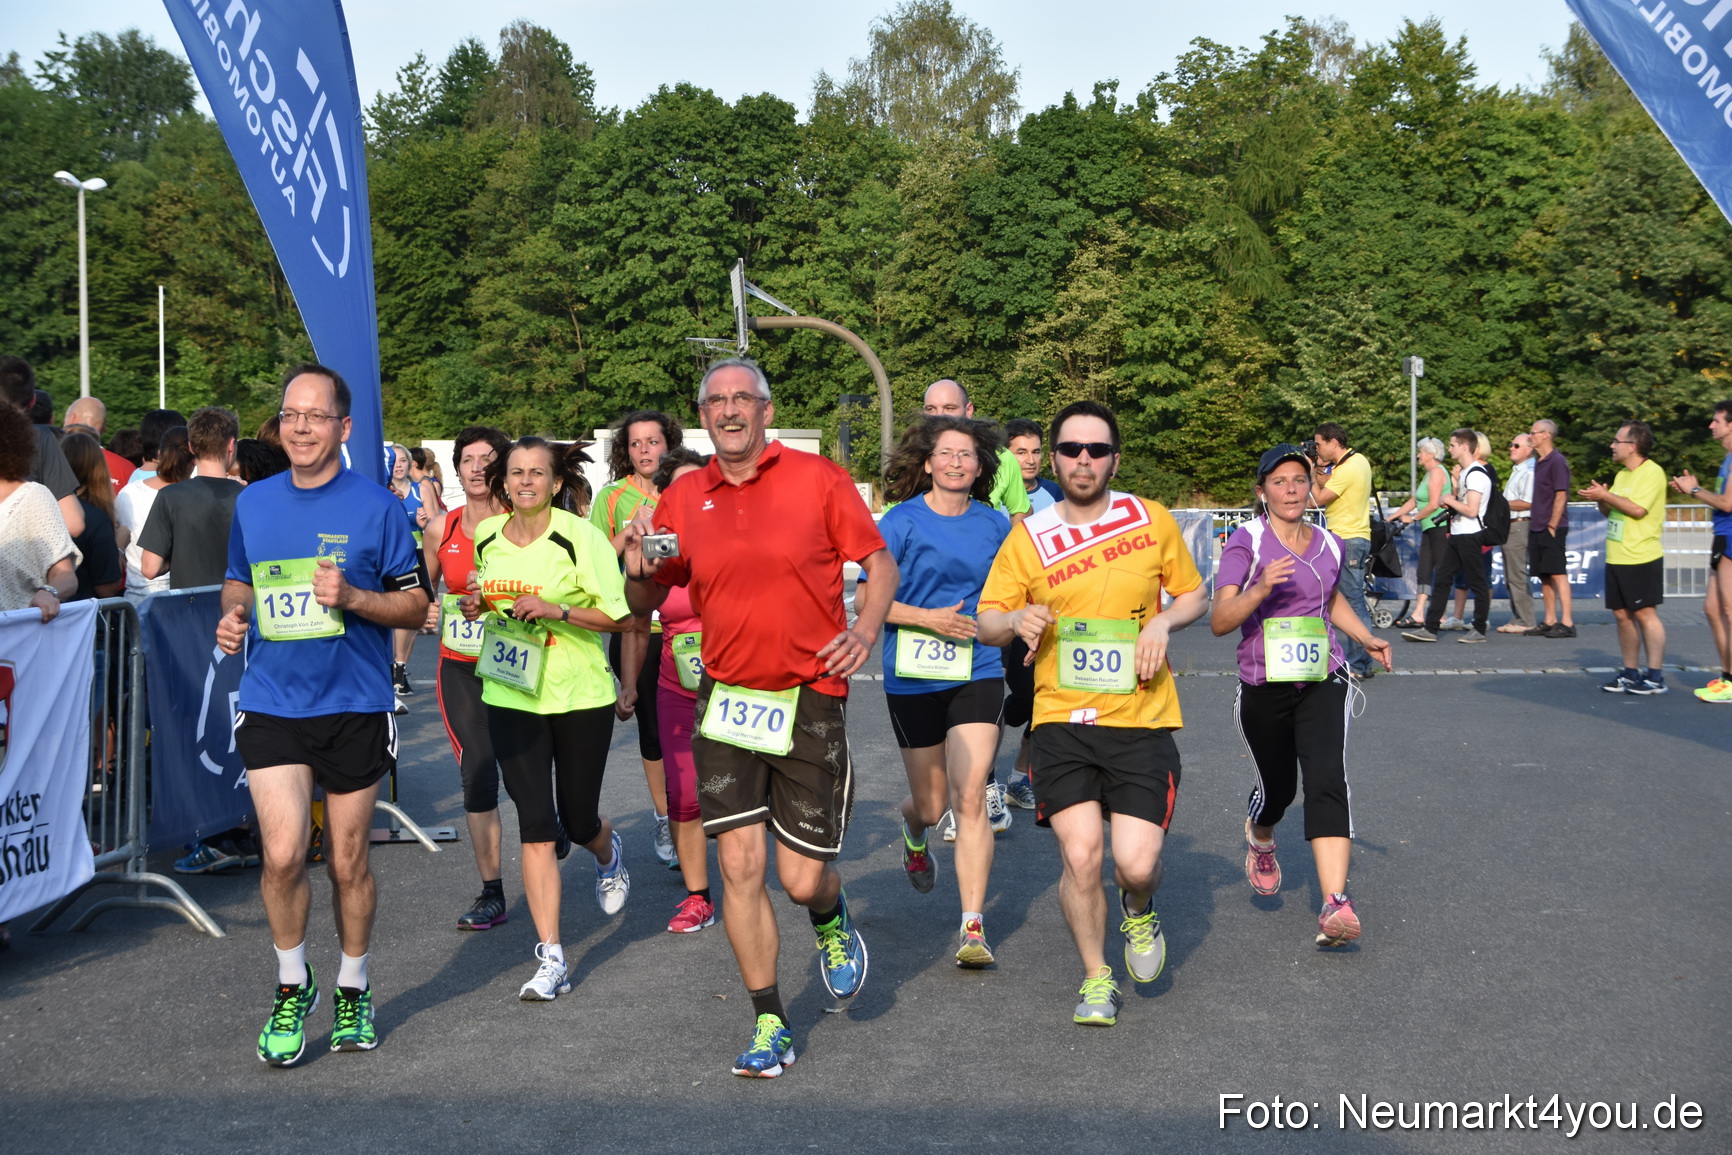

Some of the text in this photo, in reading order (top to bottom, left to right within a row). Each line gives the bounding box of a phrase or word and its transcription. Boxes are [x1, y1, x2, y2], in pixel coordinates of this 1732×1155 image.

[1047, 533, 1157, 588] MAX BÖGL
[483, 579, 543, 596] Müller
[493, 641, 529, 671] 341
[913, 638, 957, 662] 738
[1072, 647, 1122, 673] 930
[1280, 642, 1320, 663] 305
[719, 697, 785, 733] 1370
[0, 789, 41, 827] kter
